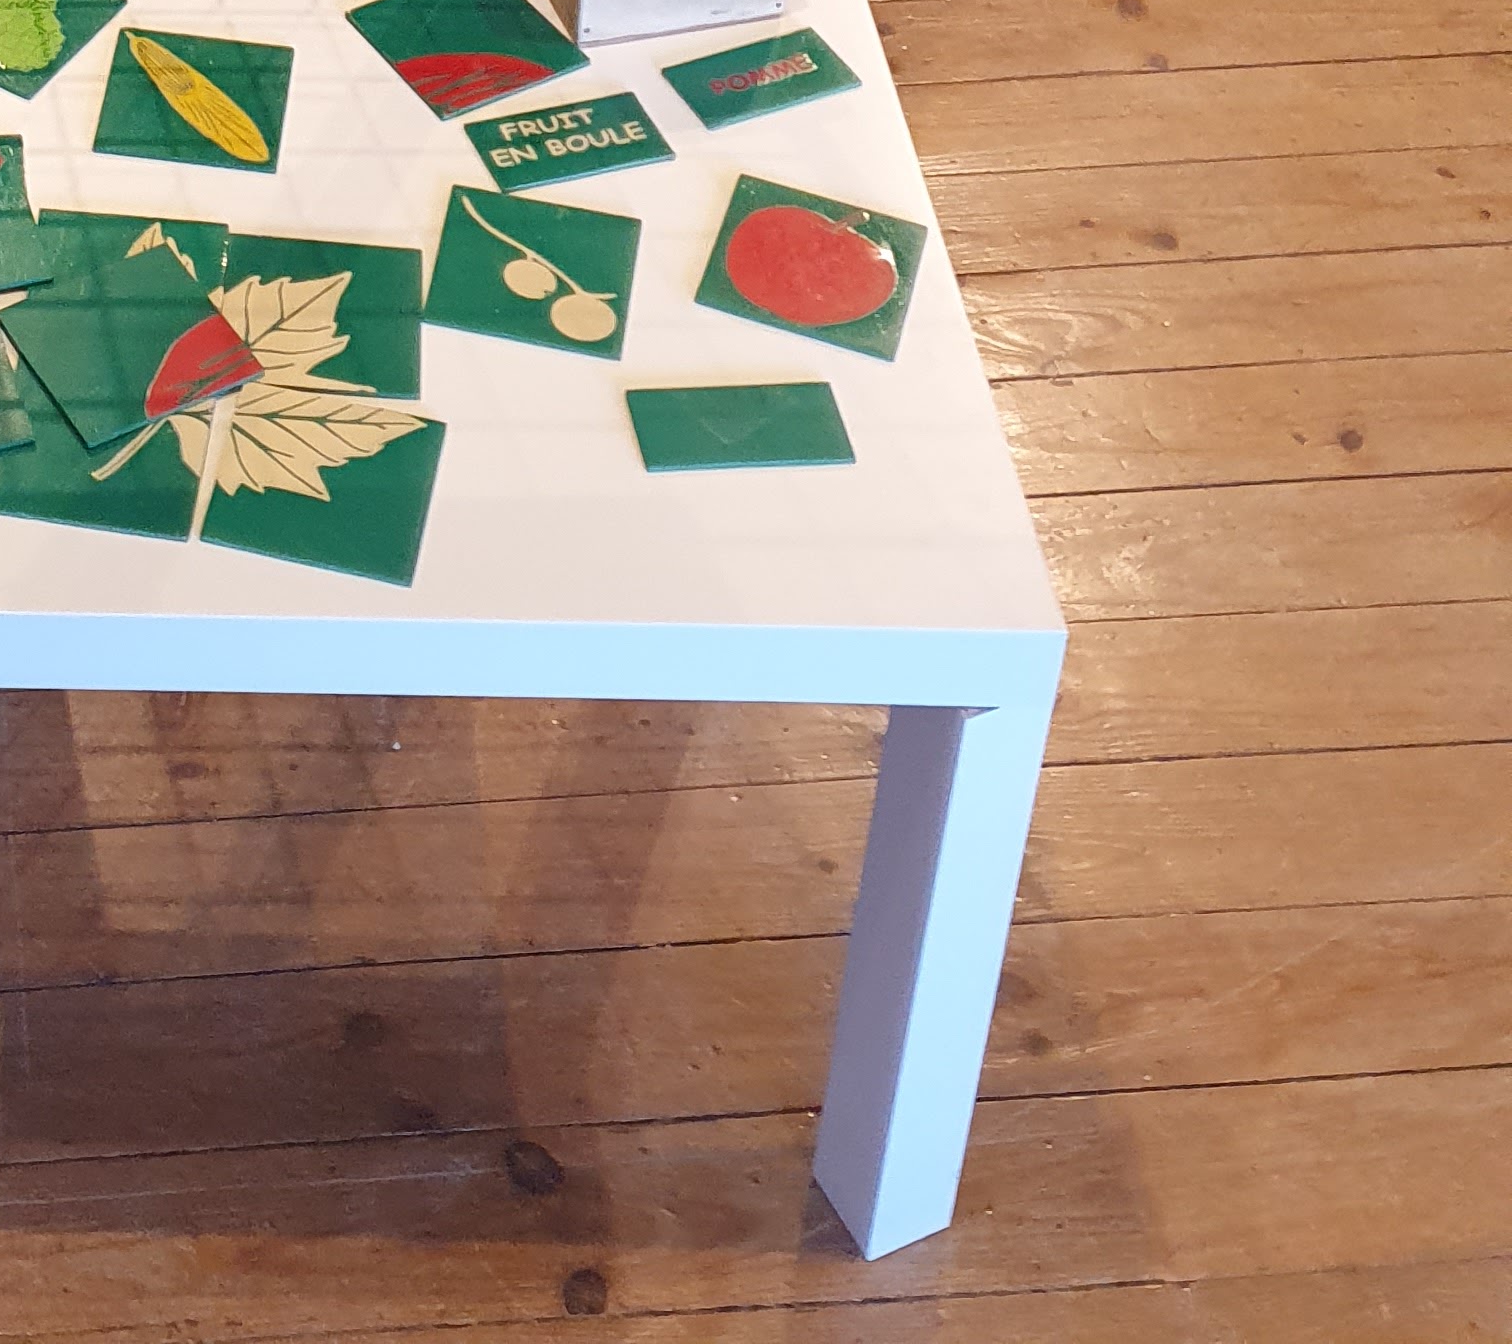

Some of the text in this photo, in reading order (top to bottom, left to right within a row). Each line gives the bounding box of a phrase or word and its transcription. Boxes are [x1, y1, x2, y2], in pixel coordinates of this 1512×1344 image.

[489, 121, 648, 168] EN BOULE
[500, 110, 594, 141] FRUIT
